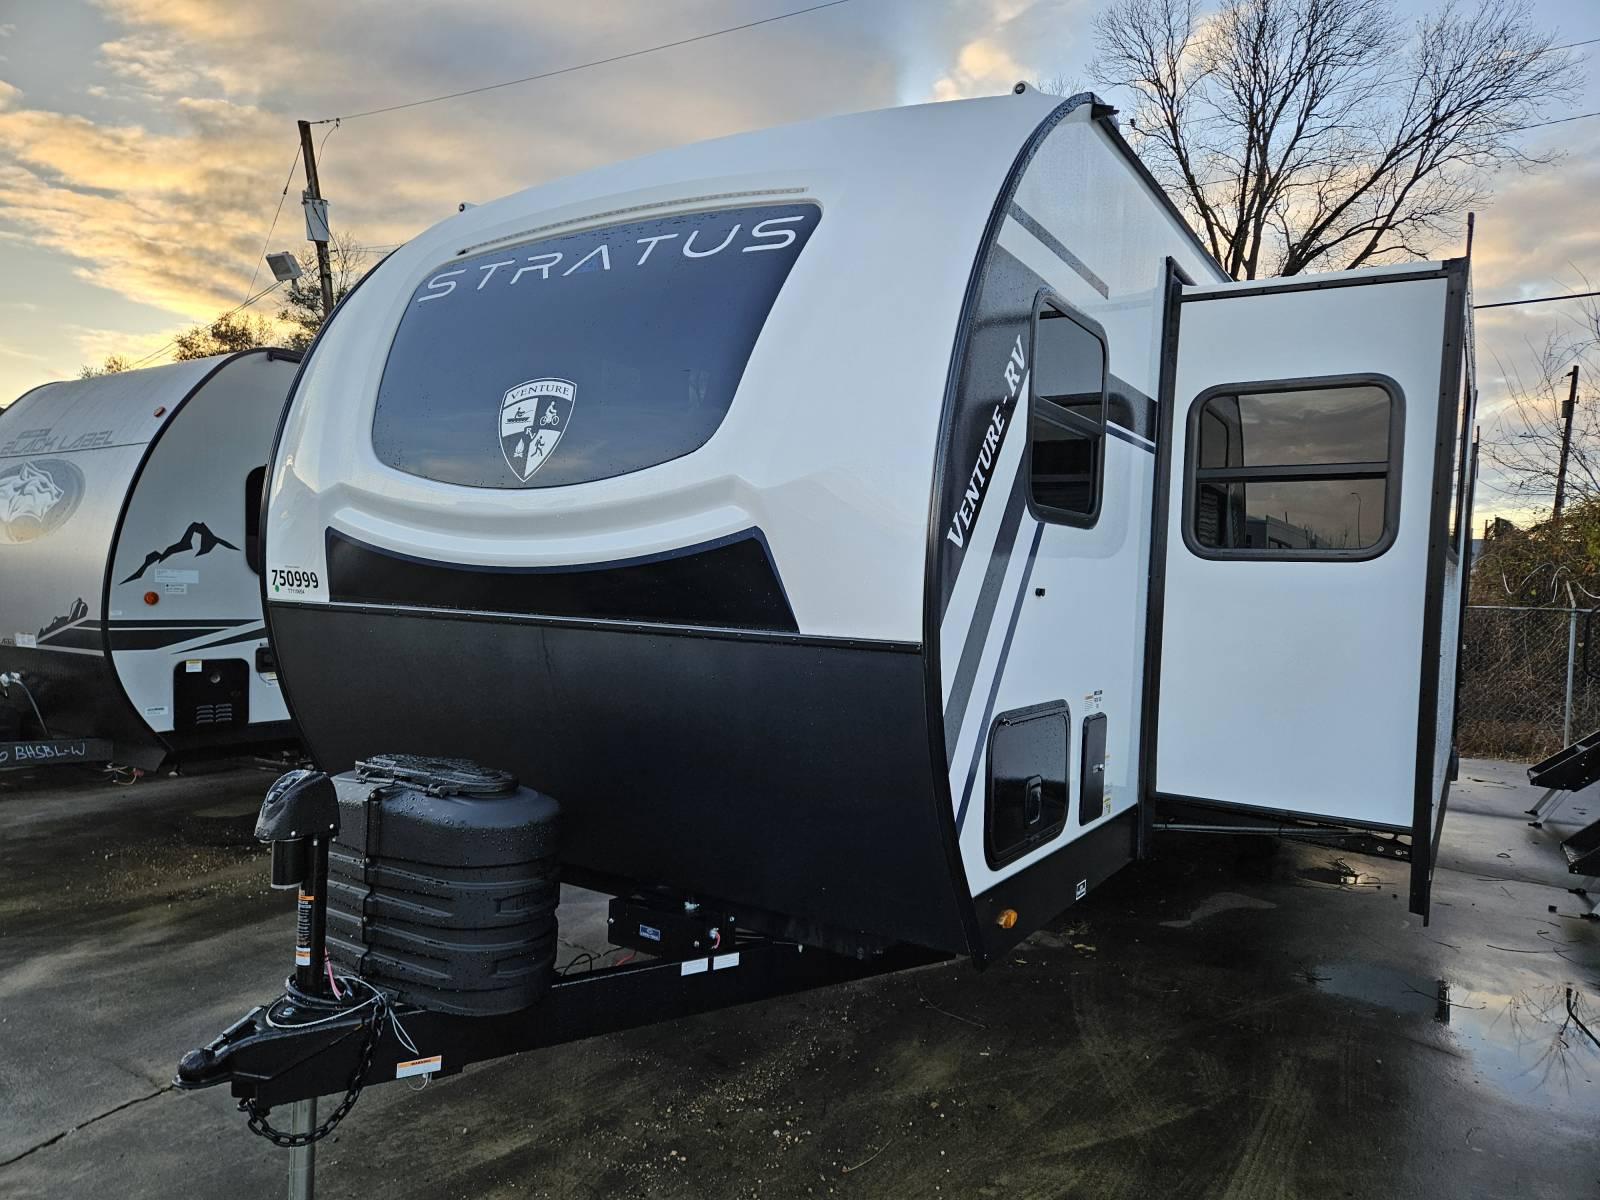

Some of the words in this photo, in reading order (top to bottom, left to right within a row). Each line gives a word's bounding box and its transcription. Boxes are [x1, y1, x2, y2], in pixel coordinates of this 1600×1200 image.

[417, 214, 805, 303] STRATUS
[511, 384, 570, 399] VENTURE
[525, 427, 536, 440] RV
[946, 405, 1005, 549] VENTURE
[1004, 334, 1026, 397] RV
[271, 569, 319, 589] 750999
